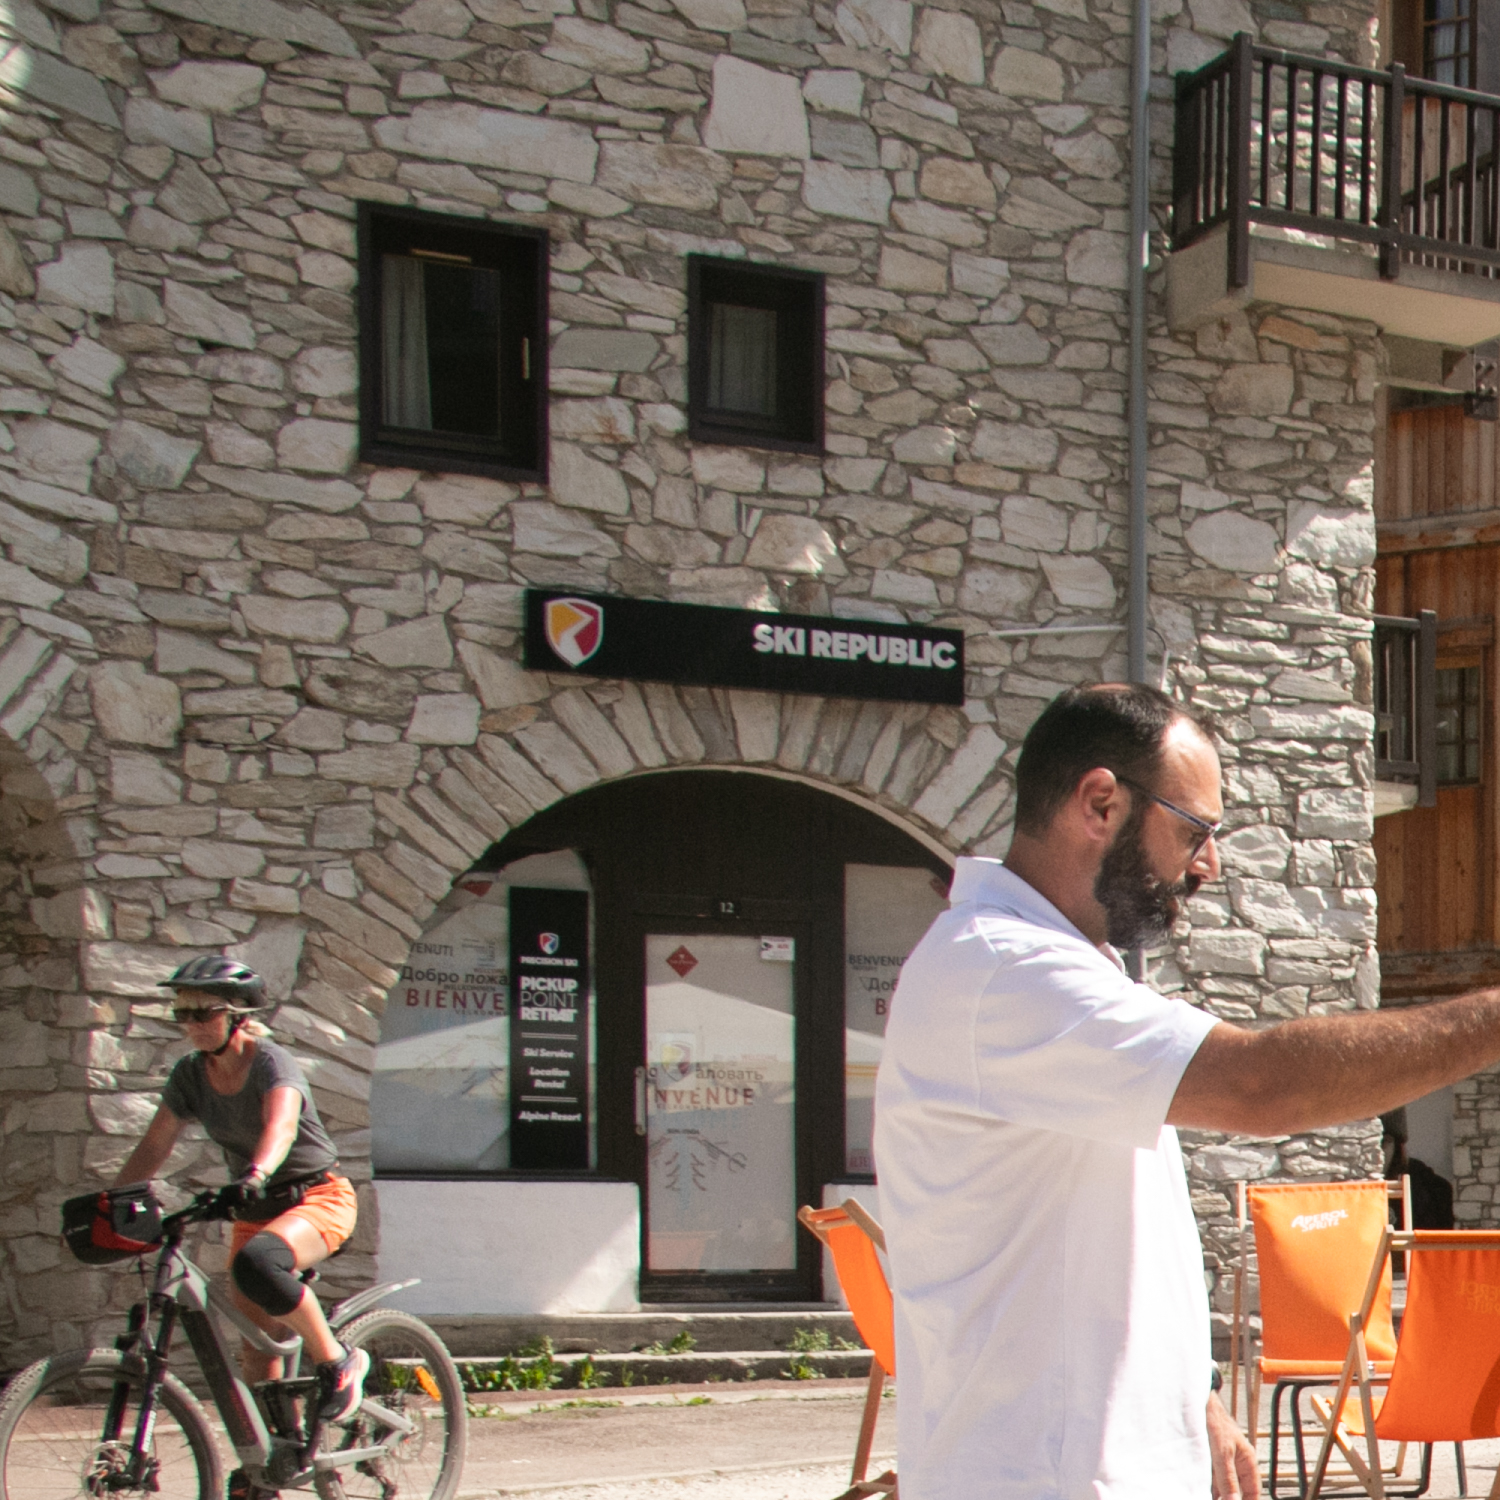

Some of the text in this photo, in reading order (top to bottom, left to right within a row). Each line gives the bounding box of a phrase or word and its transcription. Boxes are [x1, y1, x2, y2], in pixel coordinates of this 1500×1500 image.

[753, 623, 957, 670] SKI REPUBLIC
[720, 902, 735, 913] 12
[401, 965, 460, 986] Добро
[520, 976, 579, 993] PICKUP
[406, 988, 505, 1011] BIENVE
[520, 991, 579, 1008] POINT
[523, 1047, 575, 1058] Ski Service
[529, 1066, 571, 1077] Location
[533, 1079, 566, 1089] Rental
[519, 1110, 582, 1122] Alpine Resort
[1291, 1209, 1349, 1228] APEROL
